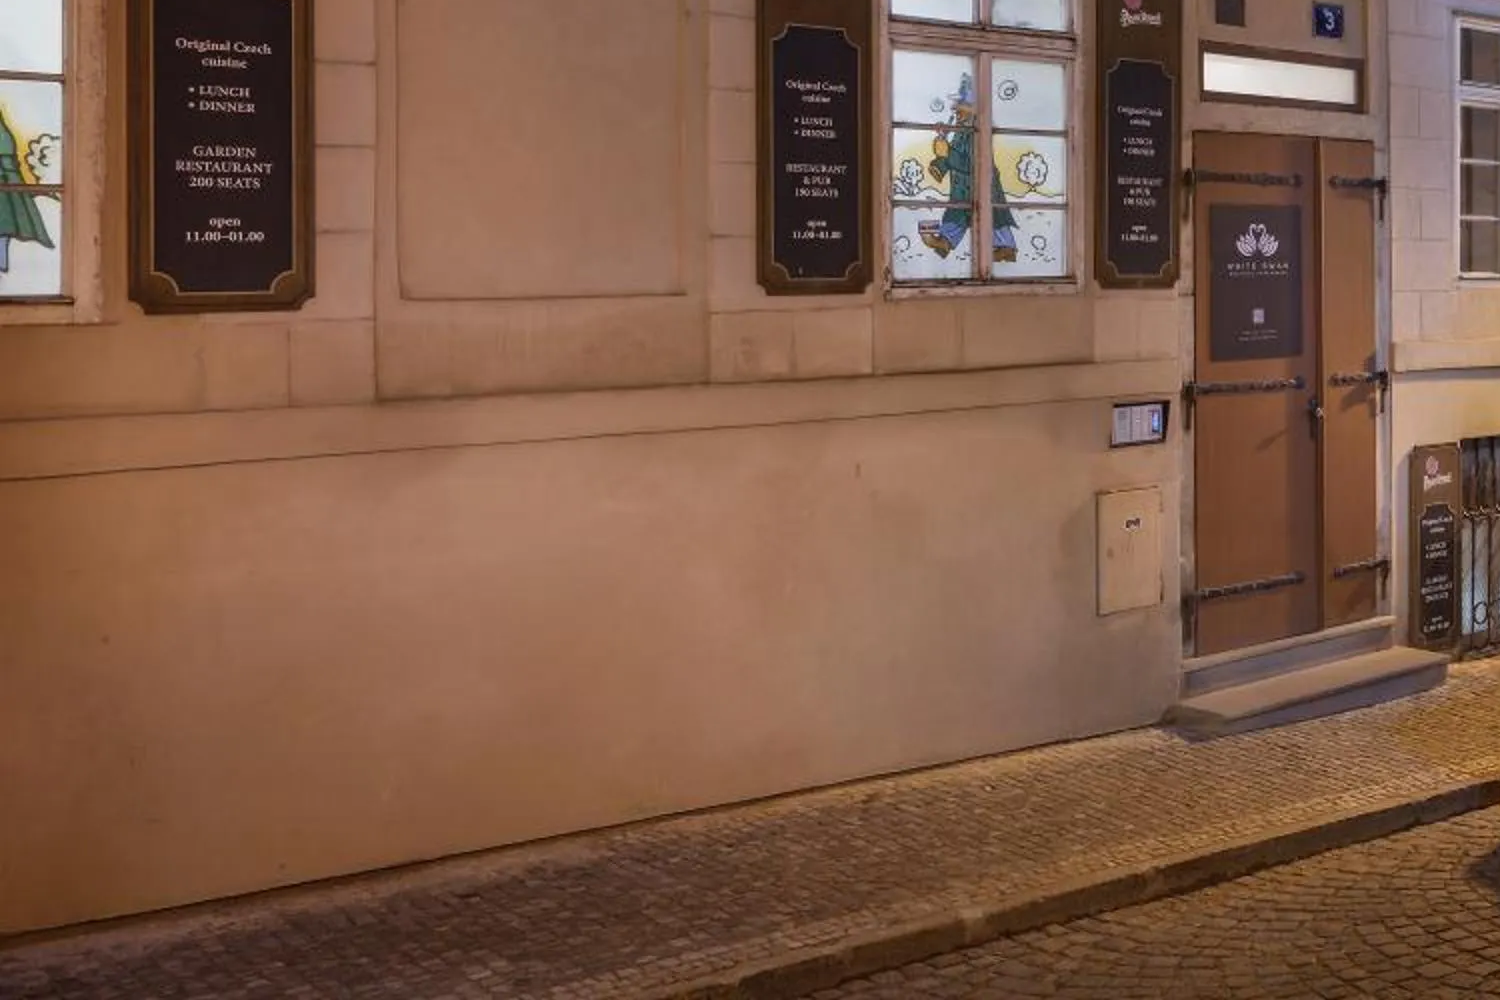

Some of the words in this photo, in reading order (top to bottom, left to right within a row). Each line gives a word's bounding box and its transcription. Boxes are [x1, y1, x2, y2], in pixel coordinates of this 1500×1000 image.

[1323, 8, 1336, 31] 3
[175, 37, 231, 53] Original
[233, 41, 273, 55] Czech
[201, 57, 247, 69] cuisine
[199, 85, 251, 98] LUNCH
[199, 100, 256, 113] DINNER
[193, 145, 257, 158] GARDEN
[175, 160, 273, 174] RESTAURANT
[189, 176, 214, 188] 200
[216, 177, 261, 189] SEATS
[209, 217, 241, 229] open
